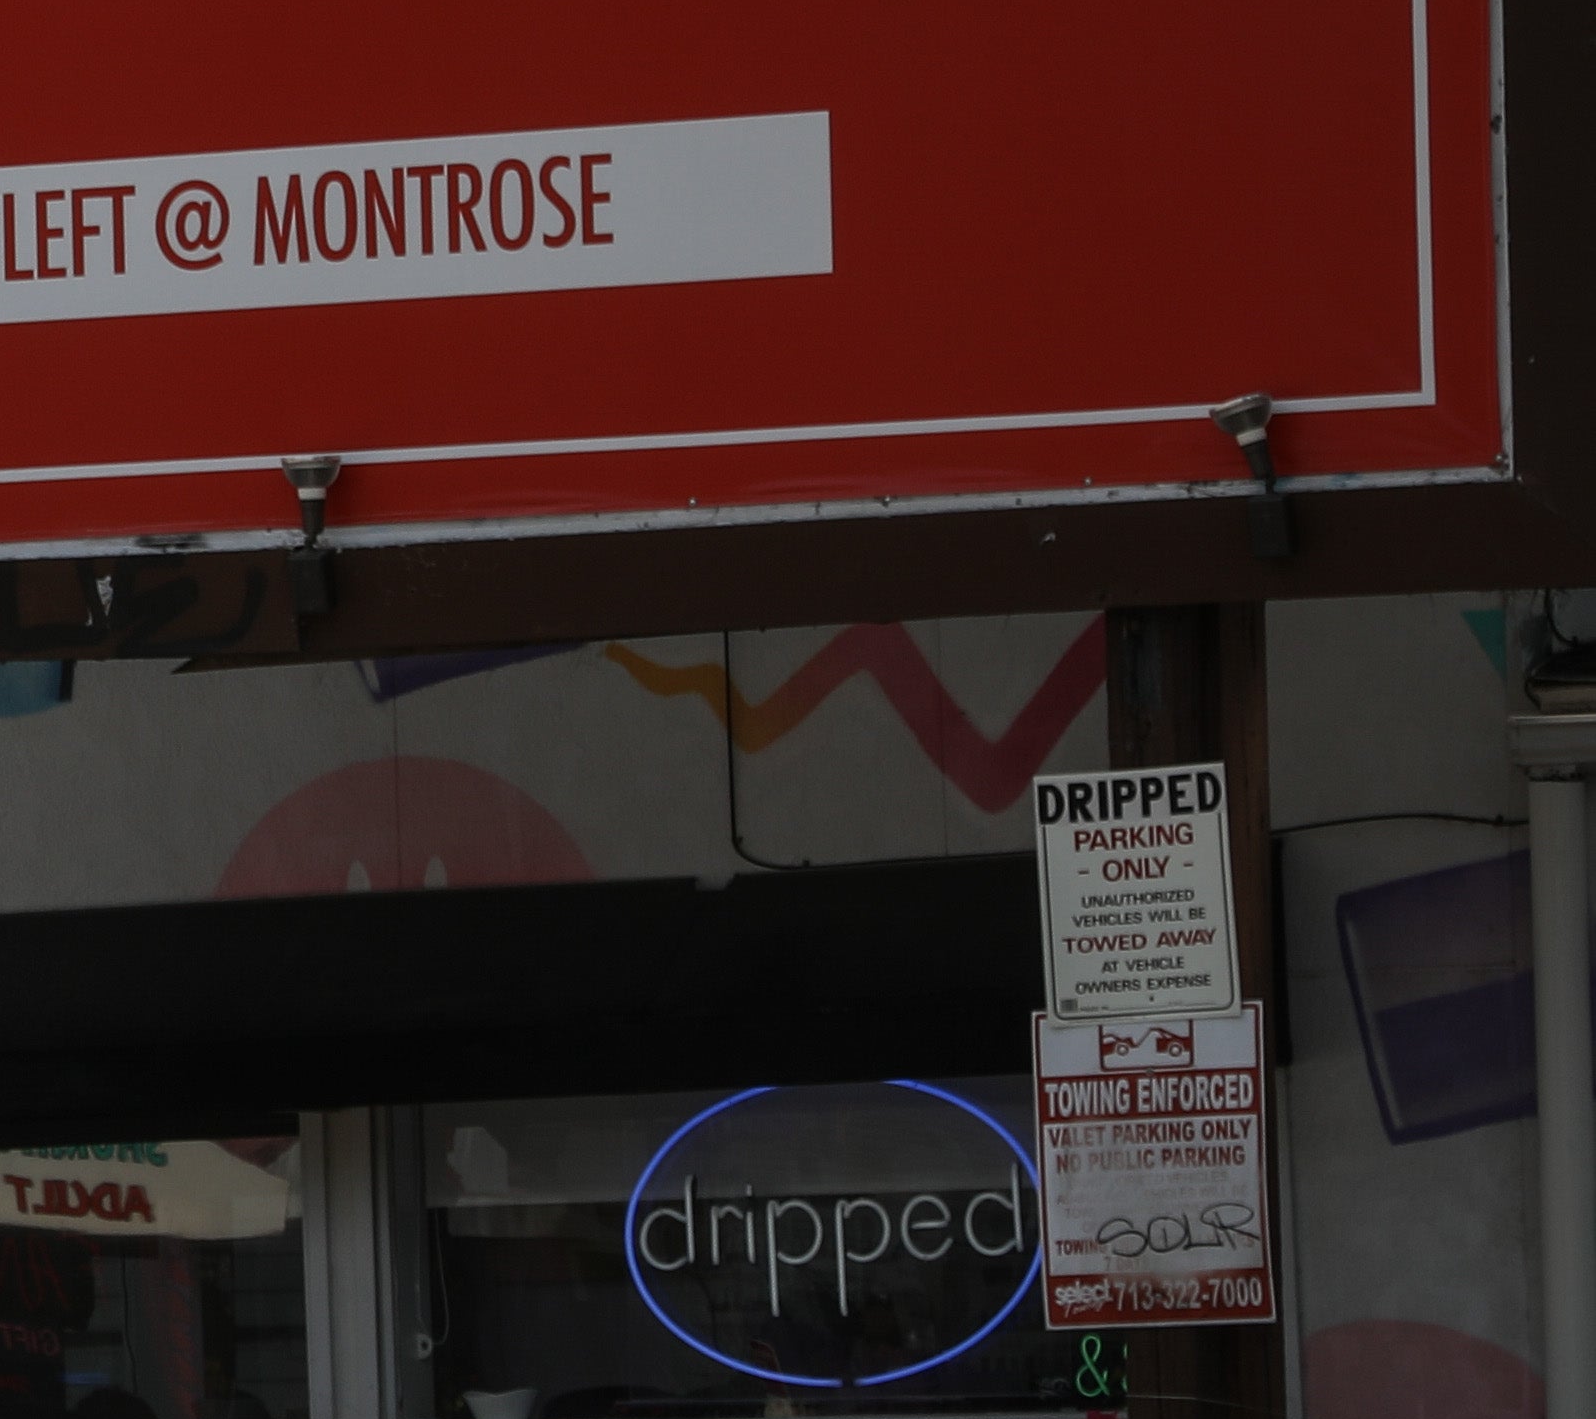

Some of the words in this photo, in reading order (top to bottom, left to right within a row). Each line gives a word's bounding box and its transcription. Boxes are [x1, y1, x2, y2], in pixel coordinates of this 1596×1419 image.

[2, 185, 136, 281] LEFT
[155, 179, 231, 271] @
[253, 153, 615, 266] MONTROSE
[1036, 771, 1223, 825] DRIPPED
[1074, 822, 1194, 852] PARKING
[1102, 855, 1170, 882] ONLY
[1081, 889, 1195, 909] UNAUTHORIZED
[1072, 912, 1143, 928] VEHICLES
[1148, 909, 1183, 923] WILL
[1189, 907, 1206, 920] BE
[1062, 933, 1147, 954] TOWED
[1156, 928, 1217, 947] AWAY
[1101, 960, 1119, 973] AT
[1125, 956, 1185, 972] VEHICLE
[1075, 979, 1141, 995] OWNERS
[1147, 974, 1212, 990] EXPENSE
[1045, 1079, 1131, 1118] TOWING
[1137, 1073, 1254, 1113] ENFORCED
[1048, 1126, 1106, 1149] VALET
[1113, 1121, 1195, 1145] PARKING
[1201, 1119, 1252, 1142] ONLY
[1056, 1153, 1081, 1174] NO
[1089, 1149, 1155, 1171] PUBLIC
[1161, 1145, 1246, 1168] PARKING
[640, 1162, 1023, 1317] dripped
[1054, 1278, 1113, 1307] select
[1114, 1277, 1263, 1312] 713-322-7000
